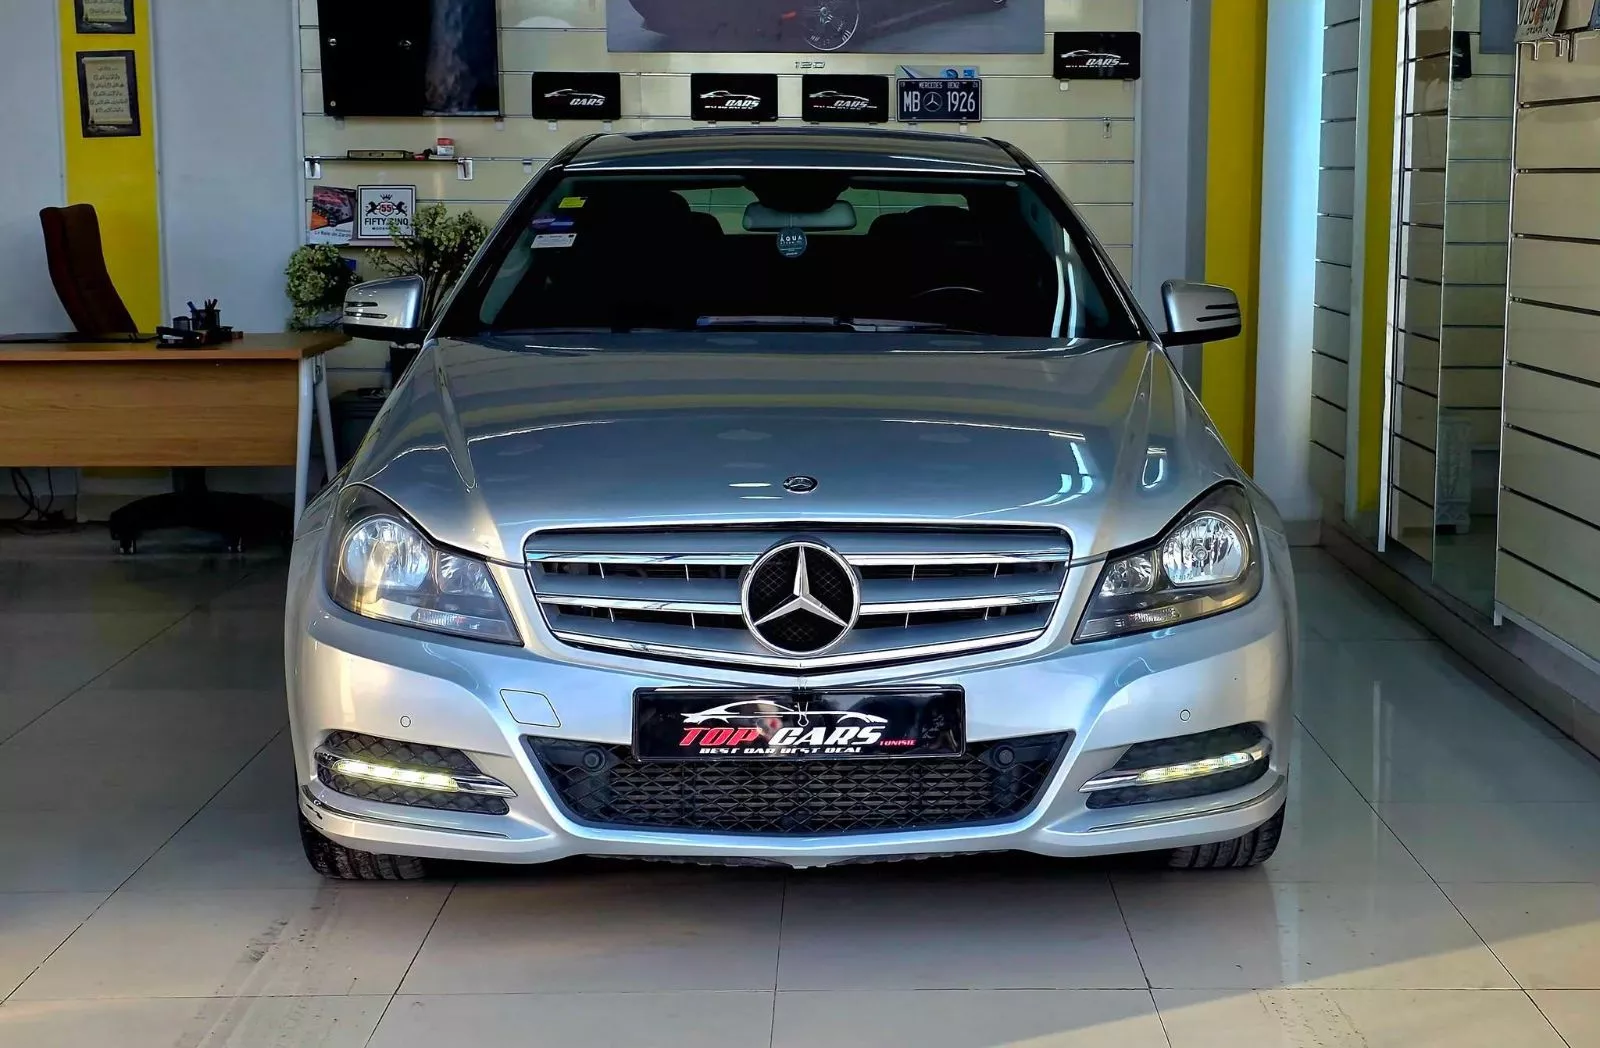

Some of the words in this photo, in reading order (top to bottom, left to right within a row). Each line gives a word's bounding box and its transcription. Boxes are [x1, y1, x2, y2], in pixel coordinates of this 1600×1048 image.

[569, 98, 605, 106] CARS
[903, 91, 920, 112] MB
[946, 91, 976, 112] 1926
[381, 204, 392, 213] 55
[364, 218, 387, 226] FIFTY
[679, 727, 762, 746] TOP
[768, 725, 886, 746] CARS
